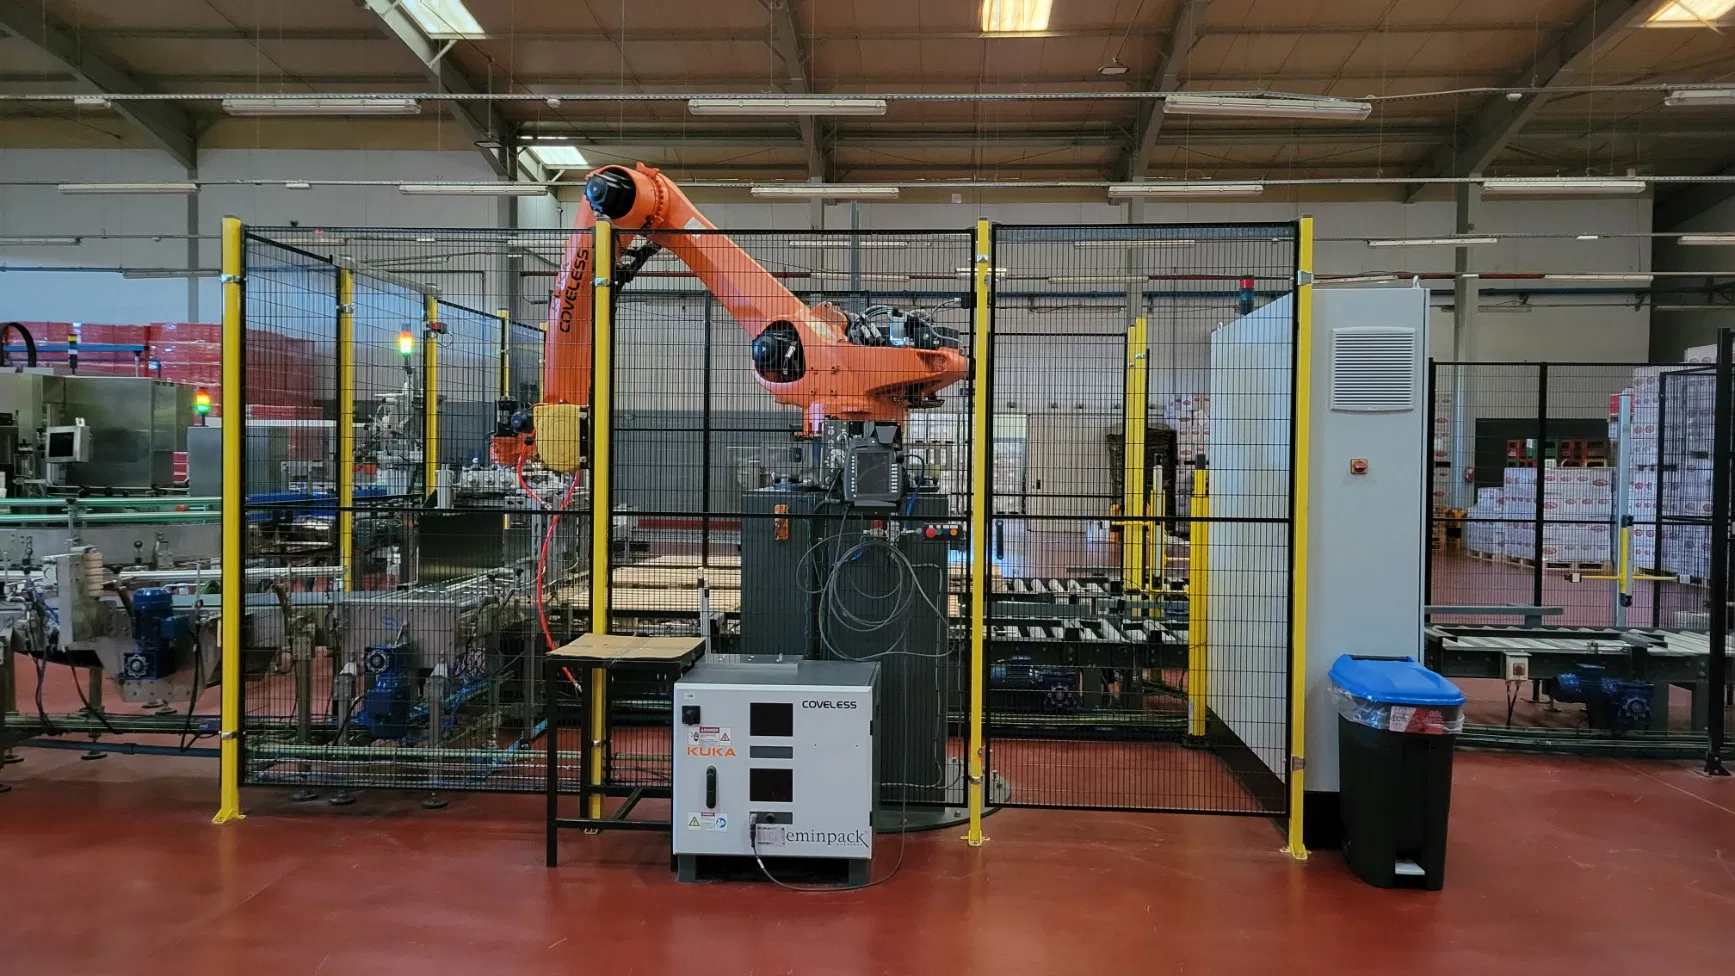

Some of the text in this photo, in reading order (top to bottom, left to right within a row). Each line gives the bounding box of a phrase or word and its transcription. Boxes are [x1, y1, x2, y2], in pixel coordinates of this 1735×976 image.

[560, 249, 589, 333] COVELESS
[801, 700, 857, 709] COVELESS
[687, 746, 736, 757] KUKA
